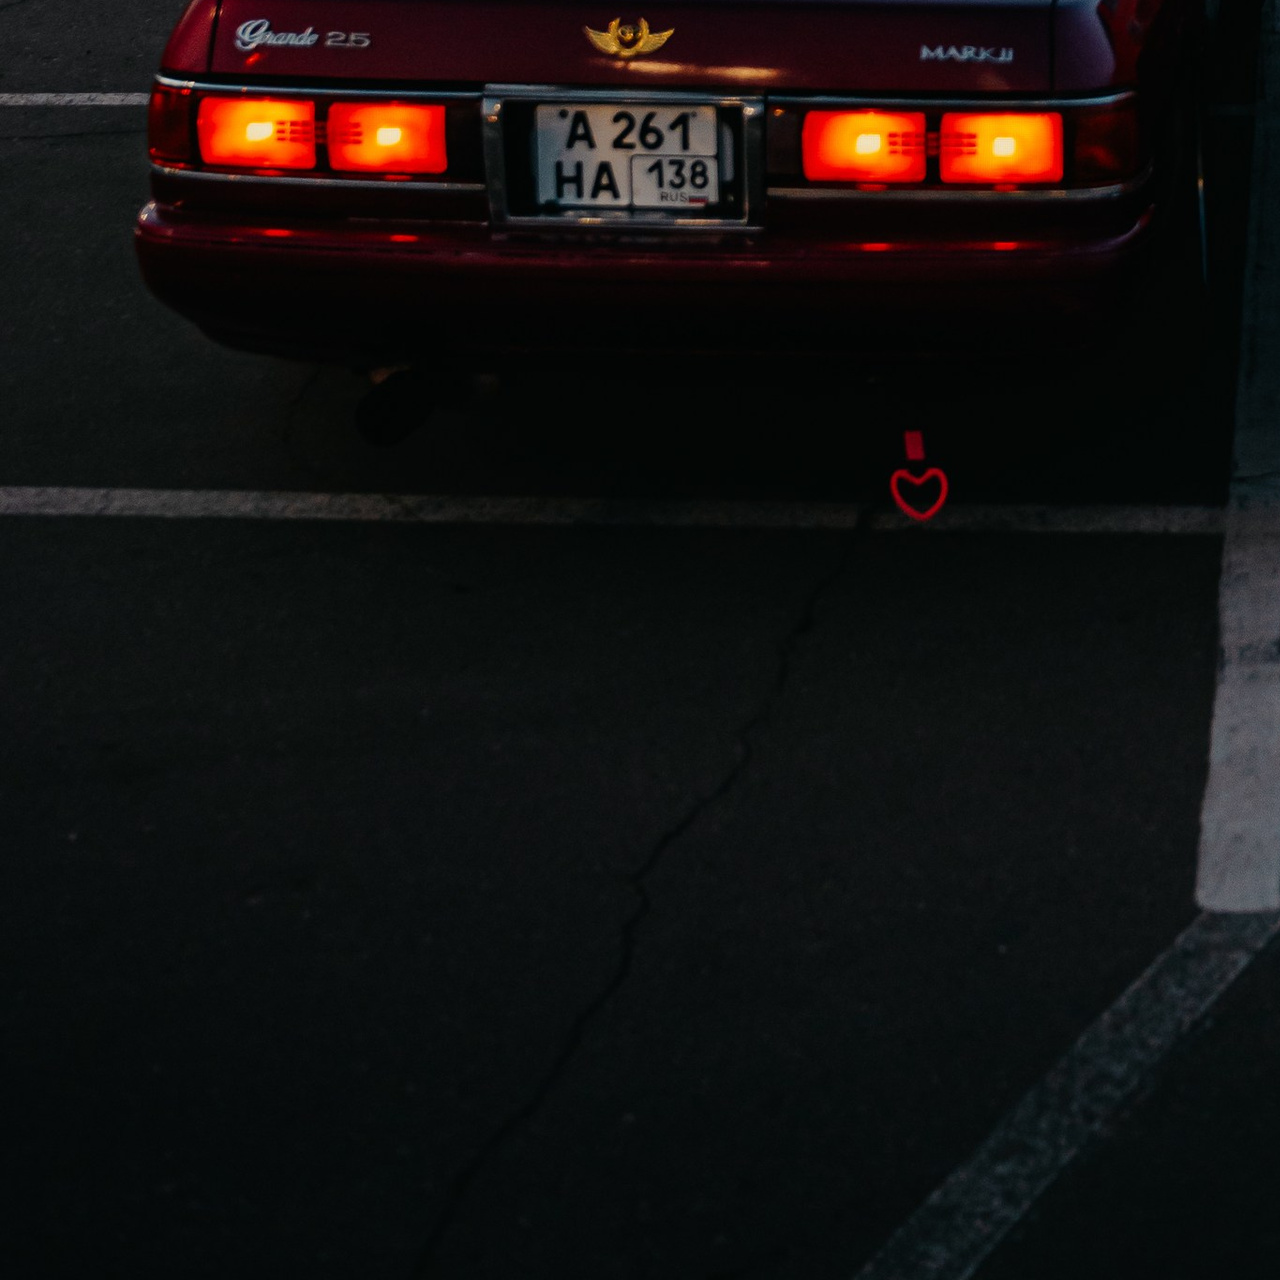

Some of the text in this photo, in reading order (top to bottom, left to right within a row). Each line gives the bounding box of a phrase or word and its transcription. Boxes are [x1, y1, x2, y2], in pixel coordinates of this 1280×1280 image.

[235, 19, 319, 51] Grande
[566, 110, 691, 150] А 261
[555, 158, 710, 199] НА 138
[660, 191, 688, 203] RUS
